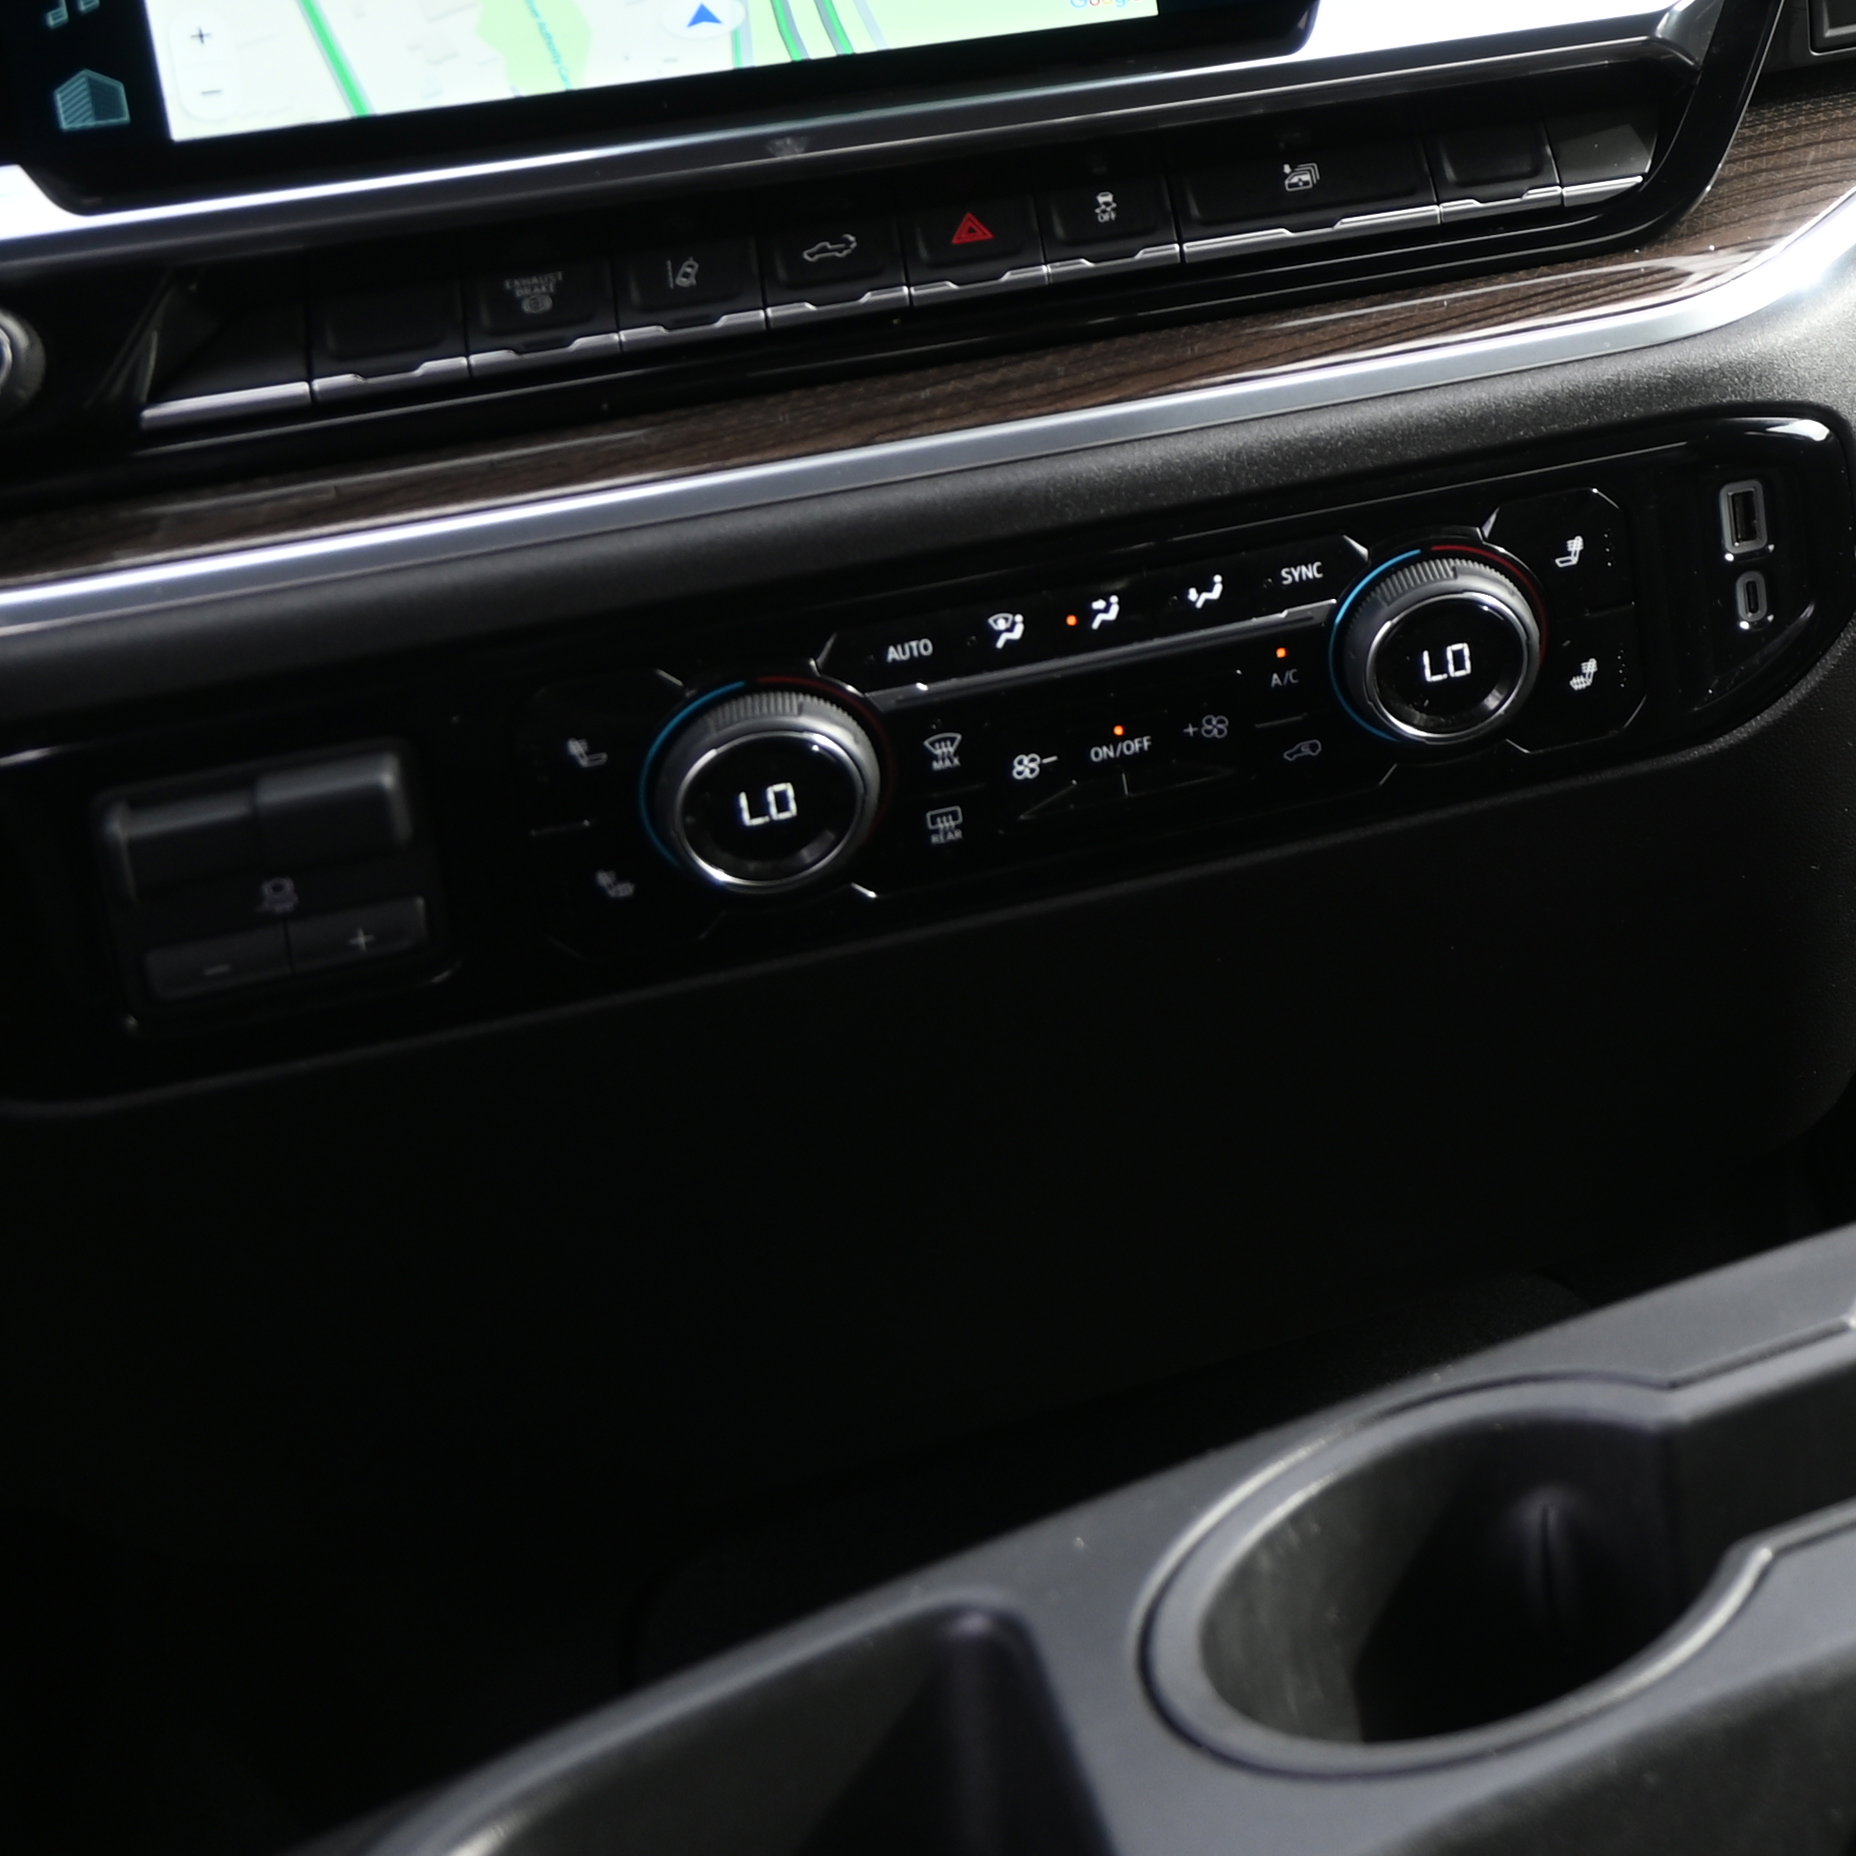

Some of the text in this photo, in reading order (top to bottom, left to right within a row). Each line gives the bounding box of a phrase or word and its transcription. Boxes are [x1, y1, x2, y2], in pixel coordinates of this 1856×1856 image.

[1280, 560, 1324, 586] SYNC
[886, 637, 933, 663] AUTO
[1269, 667, 1299, 689] A/C
[1089, 734, 1153, 763] ON/OFF
[932, 756, 961, 771] MAX
[930, 829, 963, 844] REAR
